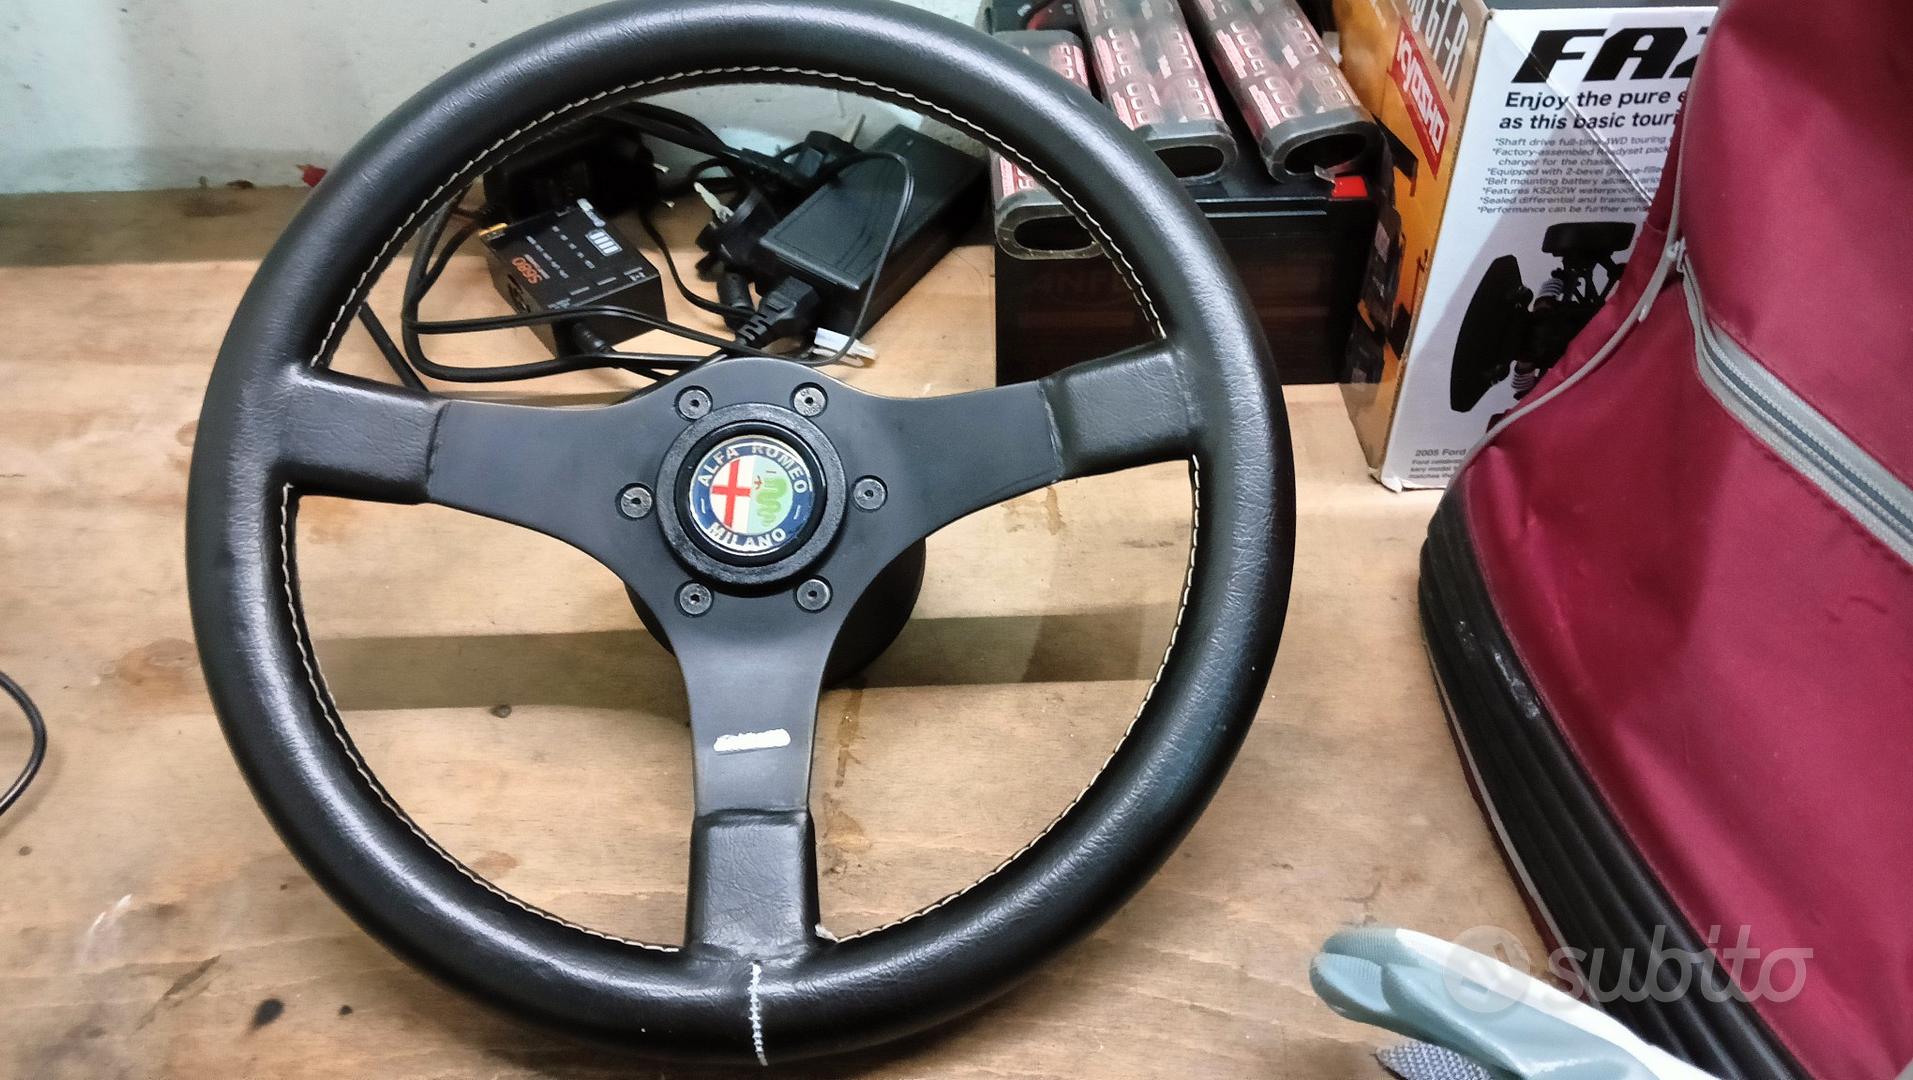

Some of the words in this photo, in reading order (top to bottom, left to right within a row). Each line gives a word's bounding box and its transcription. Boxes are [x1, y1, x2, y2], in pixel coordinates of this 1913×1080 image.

[1397, 30, 1445, 153] KYOSHO
[1505, 91, 1569, 111] Enjoy
[1576, 90, 1613, 107] the
[1617, 90, 1671, 109] pure
[1499, 116, 1523, 129] as
[1530, 114, 1567, 129] this
[1573, 112, 1626, 129] basic
[1529, 138, 1555, 146] drive
[1631, 136, 1667, 145] touring
[1498, 158, 1538, 167] charger
[1543, 158, 1557, 166] for
[1561, 158, 1578, 166] the
[1541, 167, 1563, 175] with
[1510, 177, 1558, 187] mounting
[1561, 177, 1598, 187] battery
[1519, 196, 1575, 205] differential
[1578, 196, 1598, 204] and
[1569, 205, 1582, 213] be
[1585, 205, 1619, 214] further
[1415, 448, 1440, 457] 2005
[1441, 447, 1467, 456] Ford
[698, 446, 740, 487] ALFA
[751, 445, 809, 494] ROMEO
[707, 521, 787, 548] MILANO
